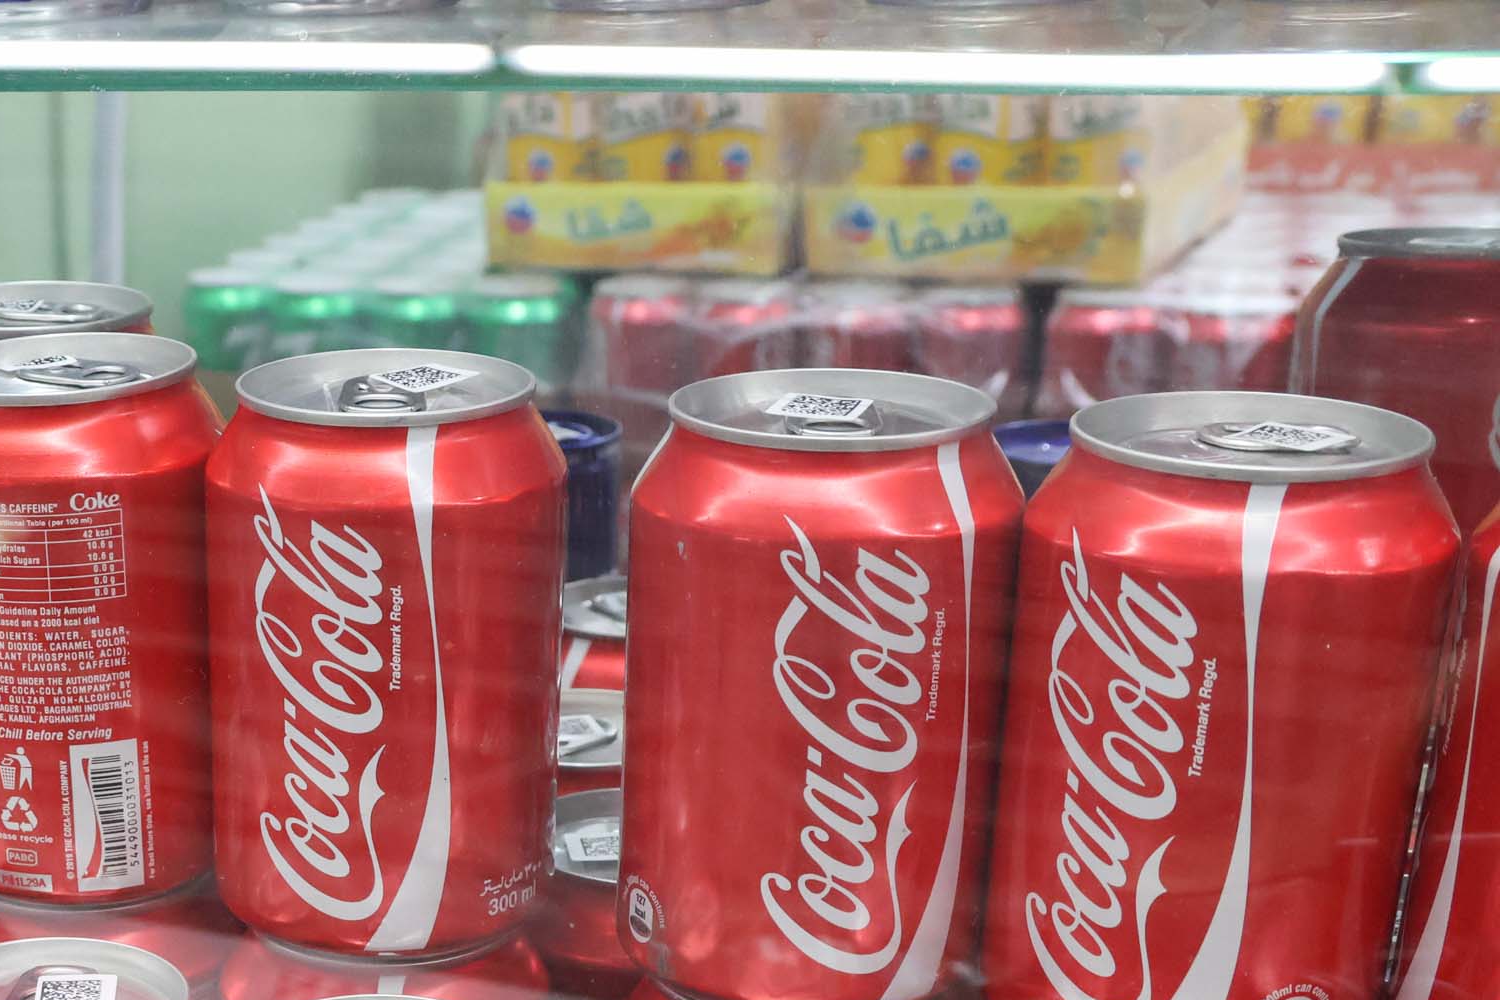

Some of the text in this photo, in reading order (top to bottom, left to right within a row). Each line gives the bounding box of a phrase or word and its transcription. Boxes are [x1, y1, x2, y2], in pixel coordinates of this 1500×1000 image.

[886, 198, 1012, 262] شفا
[69, 491, 120, 512] Coke
[25, 519, 46, 527] Table
[66, 518, 79, 526] 100
[82, 527, 113, 539] 42 kcal
[87, 541, 106, 550] 10.6
[13, 556, 41, 565] Sugars
[88, 552, 106, 561] 10.6
[93, 564, 107, 573] 0.0
[94, 576, 108, 585] 0.0
[94, 588, 109, 597] 0.0
[40, 605, 62, 617] Daily
[63, 604, 96, 615] Amount
[21, 619, 32, 627] on
[41, 618, 62, 627] 2000
[63, 617, 81, 626] kcal
[83, 615, 100, 625] diet
[389, 584, 403, 692] Trademark Regd.
[50, 640, 93, 651] CARAMEL
[27, 650, 95, 662] (PHOSPHORIC
[925, 606, 947, 722] Trademark Regd.
[17, 675, 45, 686] UNDER
[47, 675, 63, 686] THE
[65, 670, 131, 685] AUTHORIZATION
[11, 684, 64, 696] COCA-COLA
[66, 681, 117, 695] COMPANY"
[119, 680, 131, 690] BY
[8, 695, 46, 705] GULZAR
[53, 689, 132, 705] NON-ALCOHOLIC
[254, 481, 386, 921] Coca-Cola
[44, 704, 83, 715] BAGRAMI
[84, 699, 133, 713] INDUSTRIAL
[8, 714, 37, 725] KABUL,
[38, 713, 96, 725] AFGHANISTAN
[1187, 656, 1218, 779] Trademark Regd.
[25, 728, 64, 741] Before
[67, 727, 113, 741] Serving
[761, 514, 930, 975] Coca-Cola
[59, 760, 70, 796] COMPANY
[60, 798, 73, 839] COCA-COLA
[19, 834, 54, 844] recycle
[64, 841, 74, 855] THE
[488, 879, 537, 916] 300 ml
[1294, 983, 1313, 993] can
